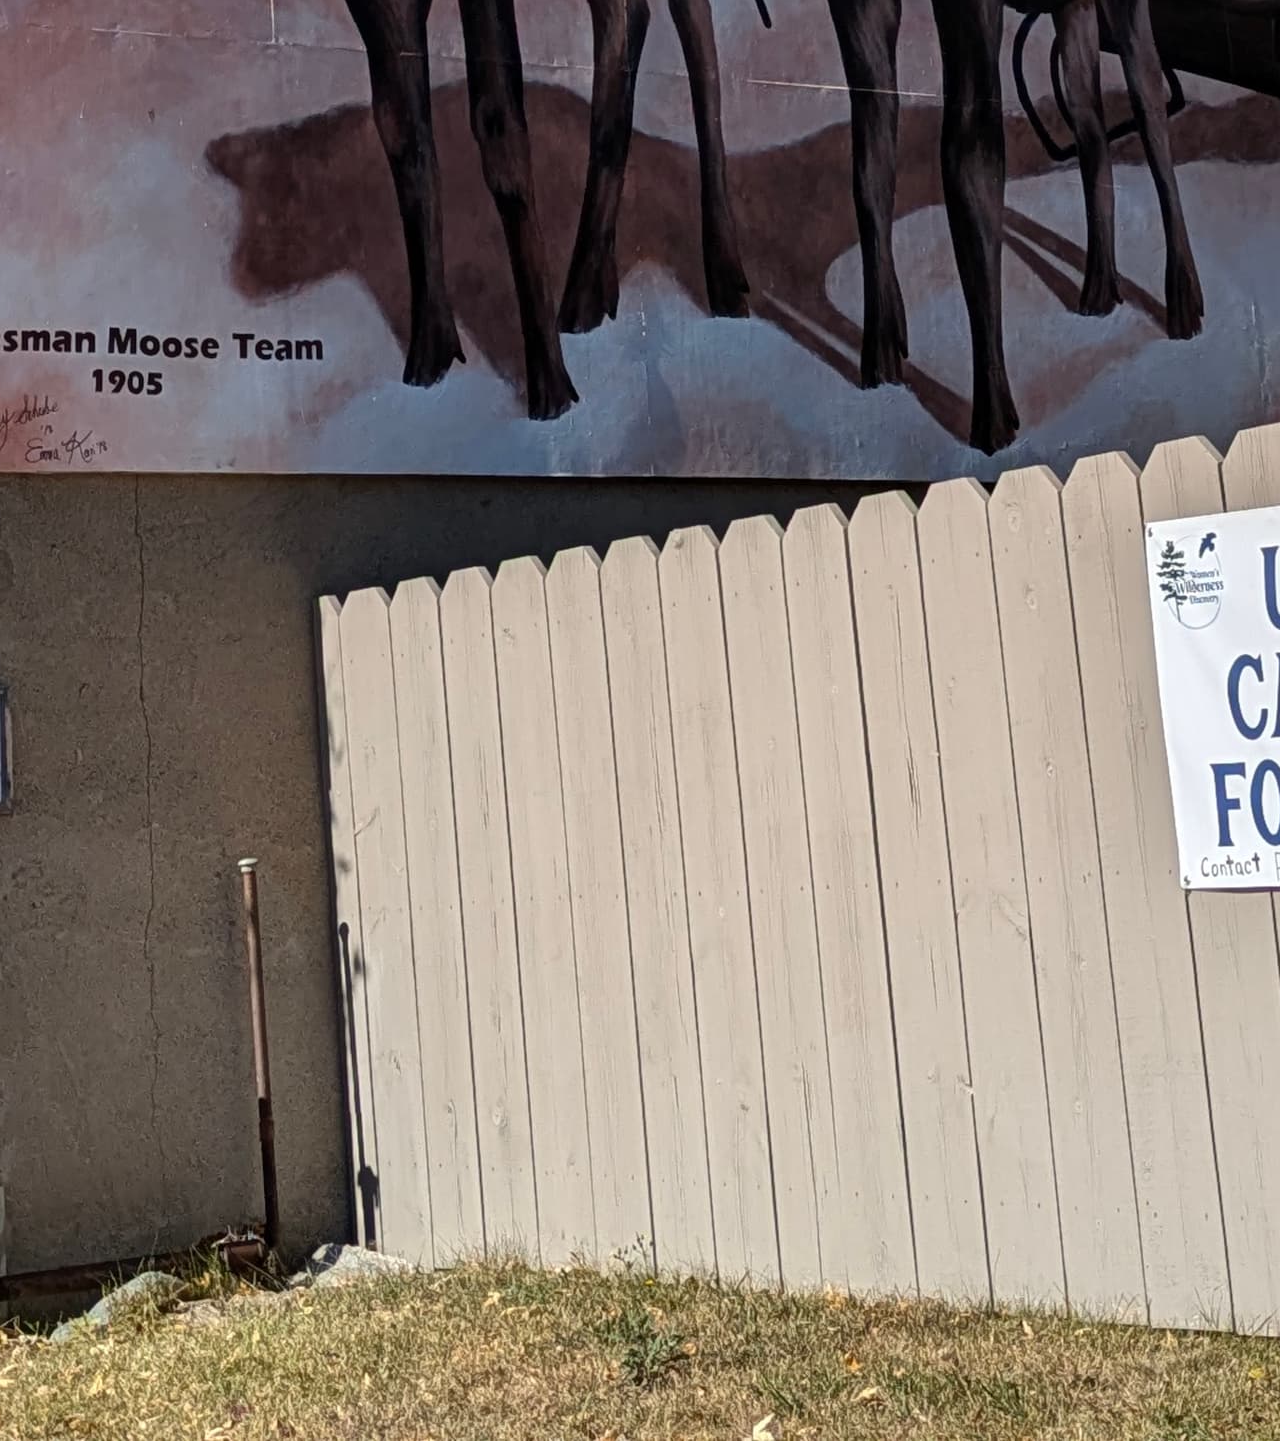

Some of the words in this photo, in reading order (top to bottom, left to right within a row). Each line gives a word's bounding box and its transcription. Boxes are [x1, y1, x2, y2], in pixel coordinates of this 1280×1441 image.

[108, 326, 220, 360] Moose
[232, 332, 324, 361] Team
[91, 368, 163, 396] 1905
[1200, 852, 1261, 878] Contact
